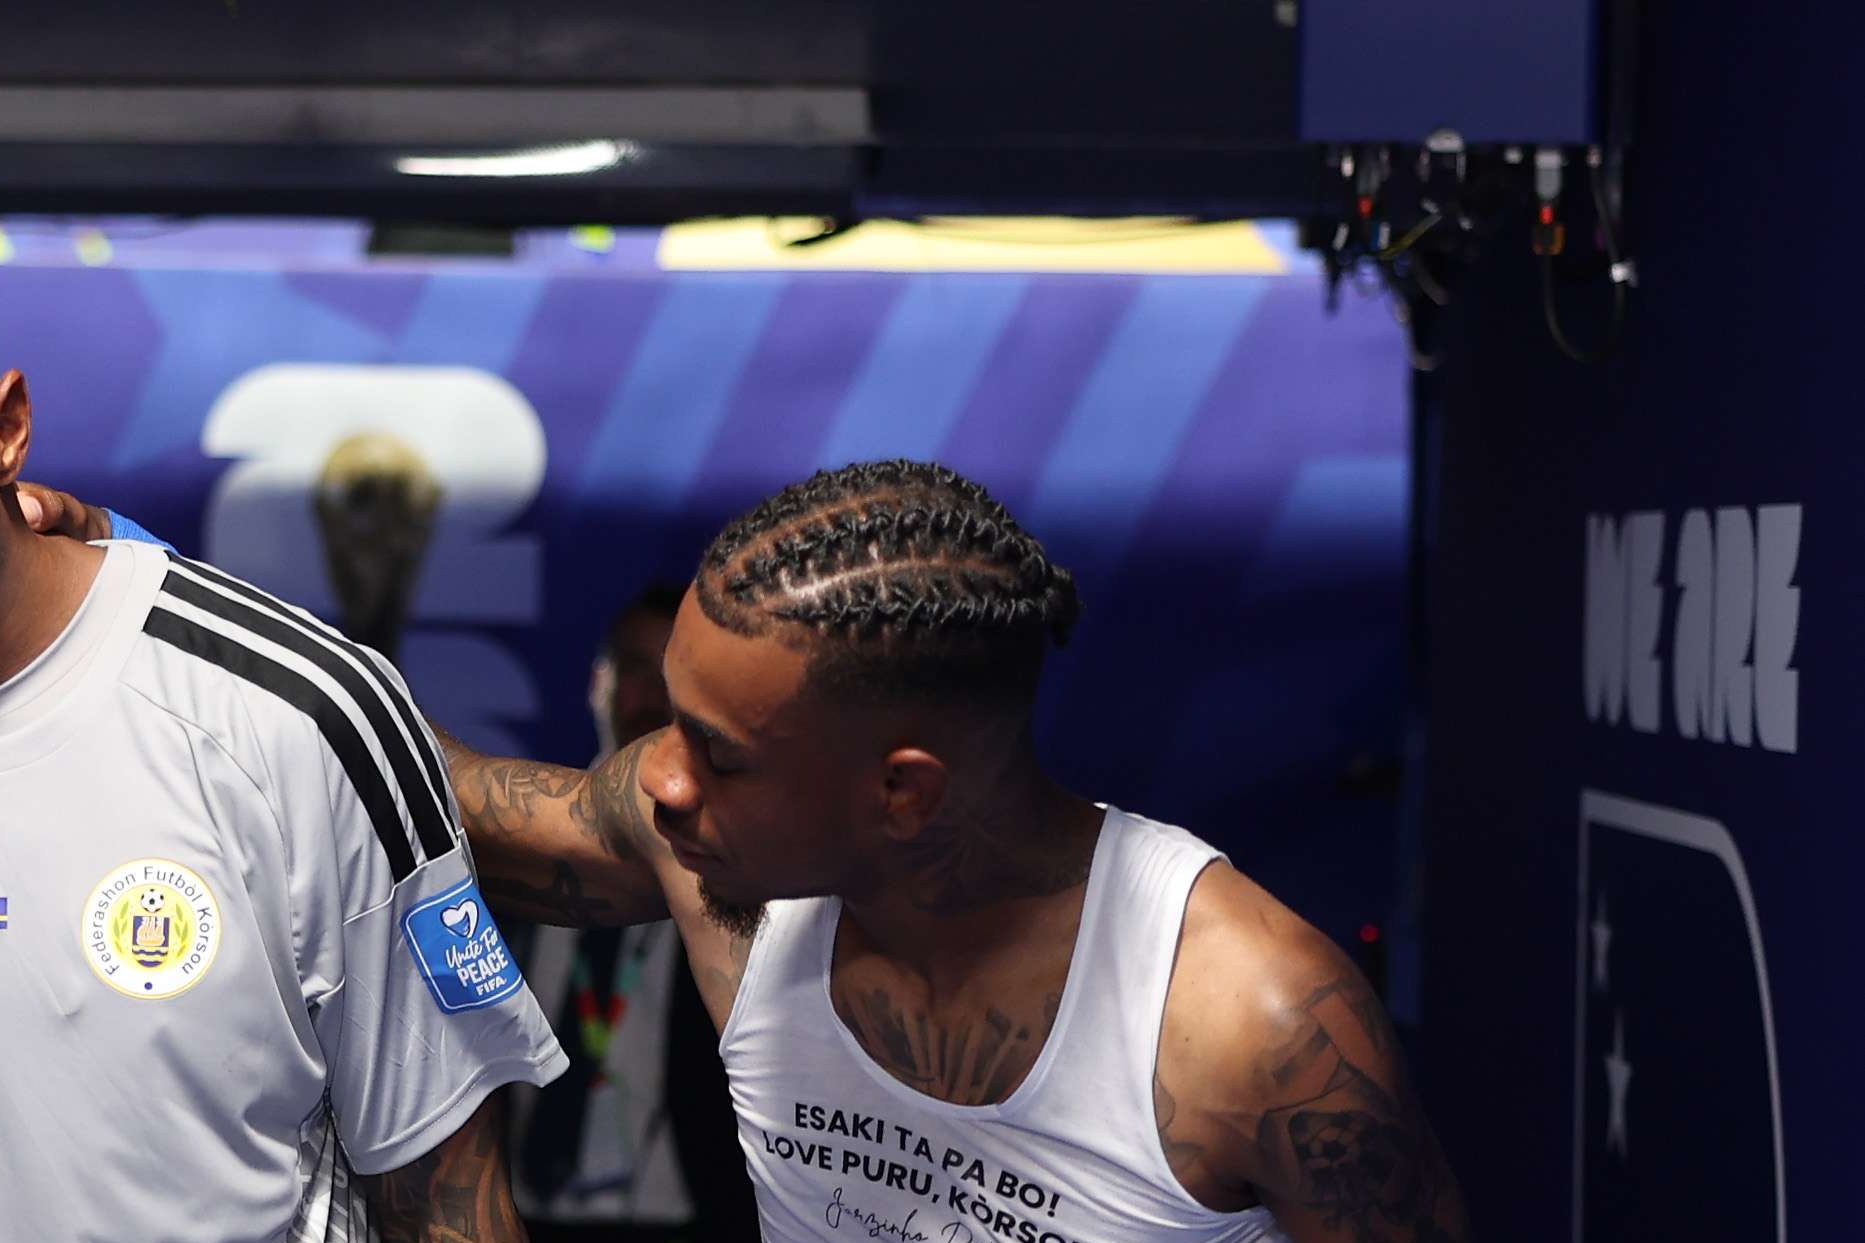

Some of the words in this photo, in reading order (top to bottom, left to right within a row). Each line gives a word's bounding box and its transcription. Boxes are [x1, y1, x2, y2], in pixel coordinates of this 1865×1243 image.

[1583, 510, 1665, 734] WE
[1673, 502, 1803, 754] ARE
[91, 873, 136, 975] Federashon
[446, 940, 483, 968] Unite
[456, 946, 509, 988] PEACE
[476, 976, 508, 996] FIFA
[762, 1130, 833, 1171] LOVE
[842, 1150, 940, 1204] PURU,
[794, 1102, 885, 1145] ESAKI
[894, 1125, 933, 1164] TA
[941, 1147, 985, 1188] PA
[995, 1170, 1061, 1218] BO!
